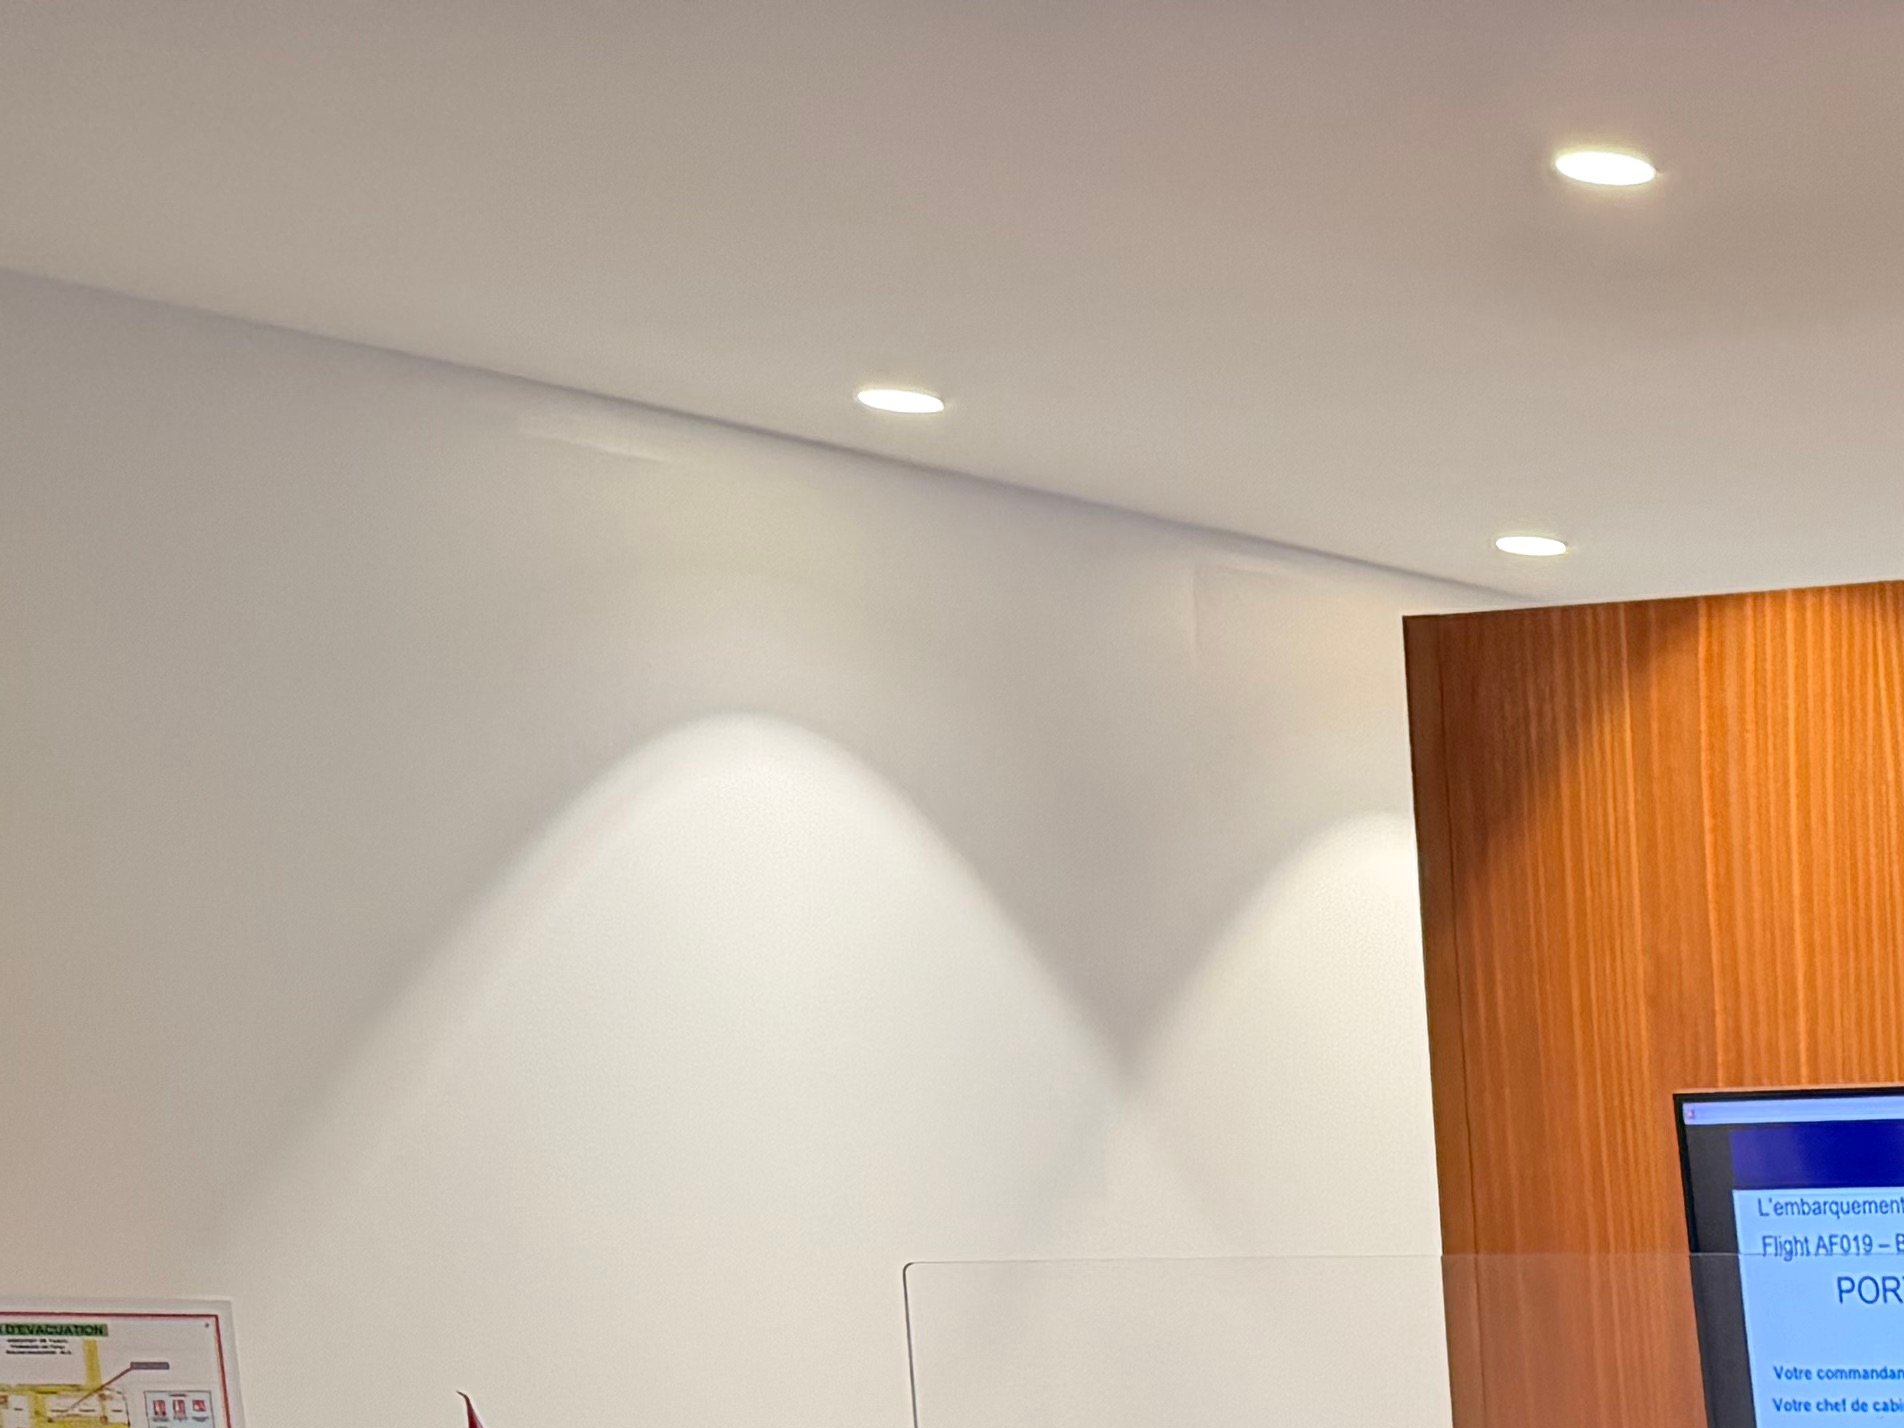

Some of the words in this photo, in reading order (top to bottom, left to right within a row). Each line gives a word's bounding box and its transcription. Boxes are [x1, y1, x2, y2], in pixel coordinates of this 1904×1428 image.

[1763, 1235, 1810, 1262] Flight
[1815, 1234, 1873, 1256] AF019
[1774, 1366, 1813, 1380] Votre
[1773, 1398, 1812, 1415] Votre
[1816, 1398, 1847, 1414] chef
[1851, 1398, 1869, 1414] de
